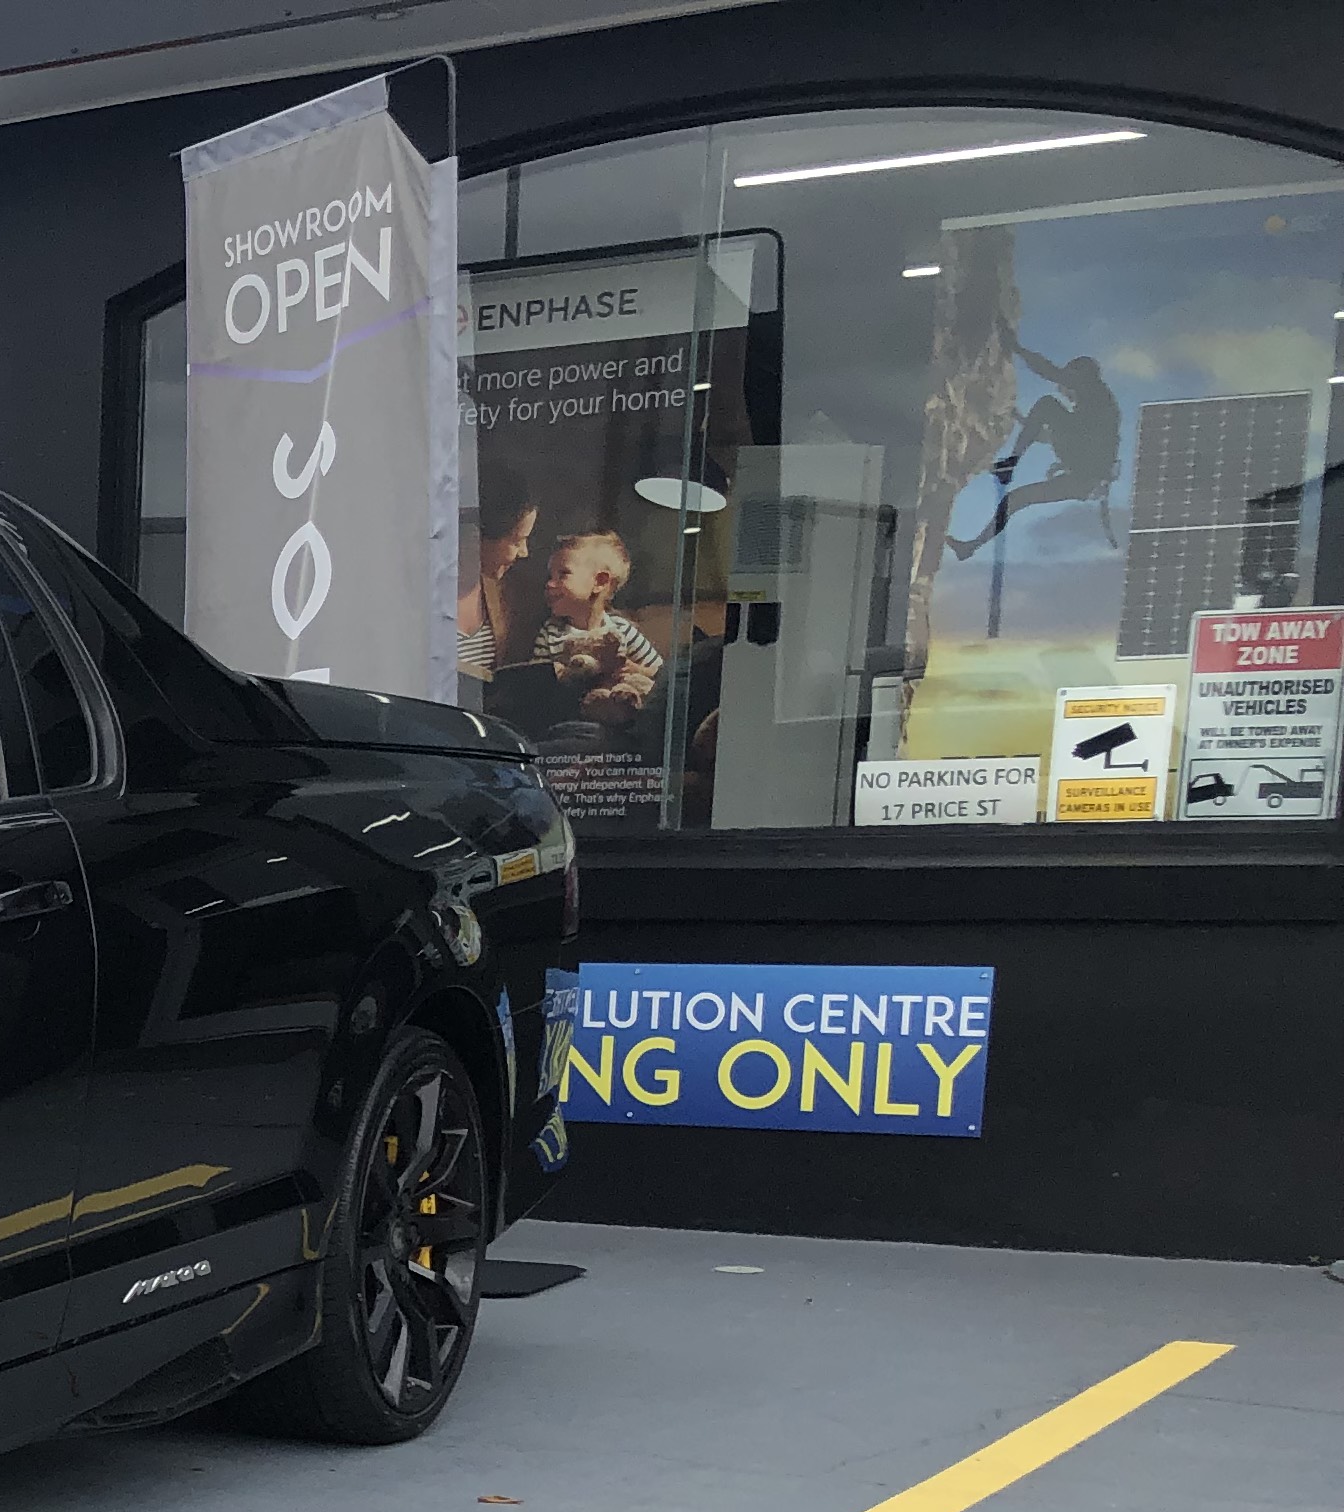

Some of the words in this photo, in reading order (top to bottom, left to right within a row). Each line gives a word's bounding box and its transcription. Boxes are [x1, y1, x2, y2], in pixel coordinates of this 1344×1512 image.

[224, 182, 392, 268] SHOWROOM
[225, 226, 392, 344] OPEN
[478, 288, 639, 331] ENPHASE
[477, 368, 542, 392] more
[548, 359, 628, 390] power
[634, 347, 683, 377] and
[509, 397, 543, 422] for
[549, 395, 605, 424] your
[612, 388, 685, 412] home
[1212, 622, 1262, 643] TOW
[1265, 619, 1331, 640] AWAY
[1237, 645, 1299, 666] ZONE
[1199, 678, 1335, 698] UNAUTHORISED
[1222, 699, 1307, 716] VEHICLES
[585, 767, 604, 777] You
[606, 768, 625, 777] can
[860, 772, 891, 789] NO
[897, 768, 987, 788] PARKING
[994, 767, 1036, 785] FOR
[1066, 786, 1147, 798] SURVEILLANCE
[881, 803, 905, 821] 17
[911, 800, 968, 819] PRICE
[976, 799, 1001, 816] ST
[1059, 803, 1111, 814] CAMERAS
[1114, 803, 1125, 812] IN
[1129, 802, 1152, 811] USE
[582, 989, 765, 1033] LUTION
[784, 993, 989, 1038] CENTRE
[559, 1036, 681, 1106] NG
[717, 1038, 982, 1118] ONLY
